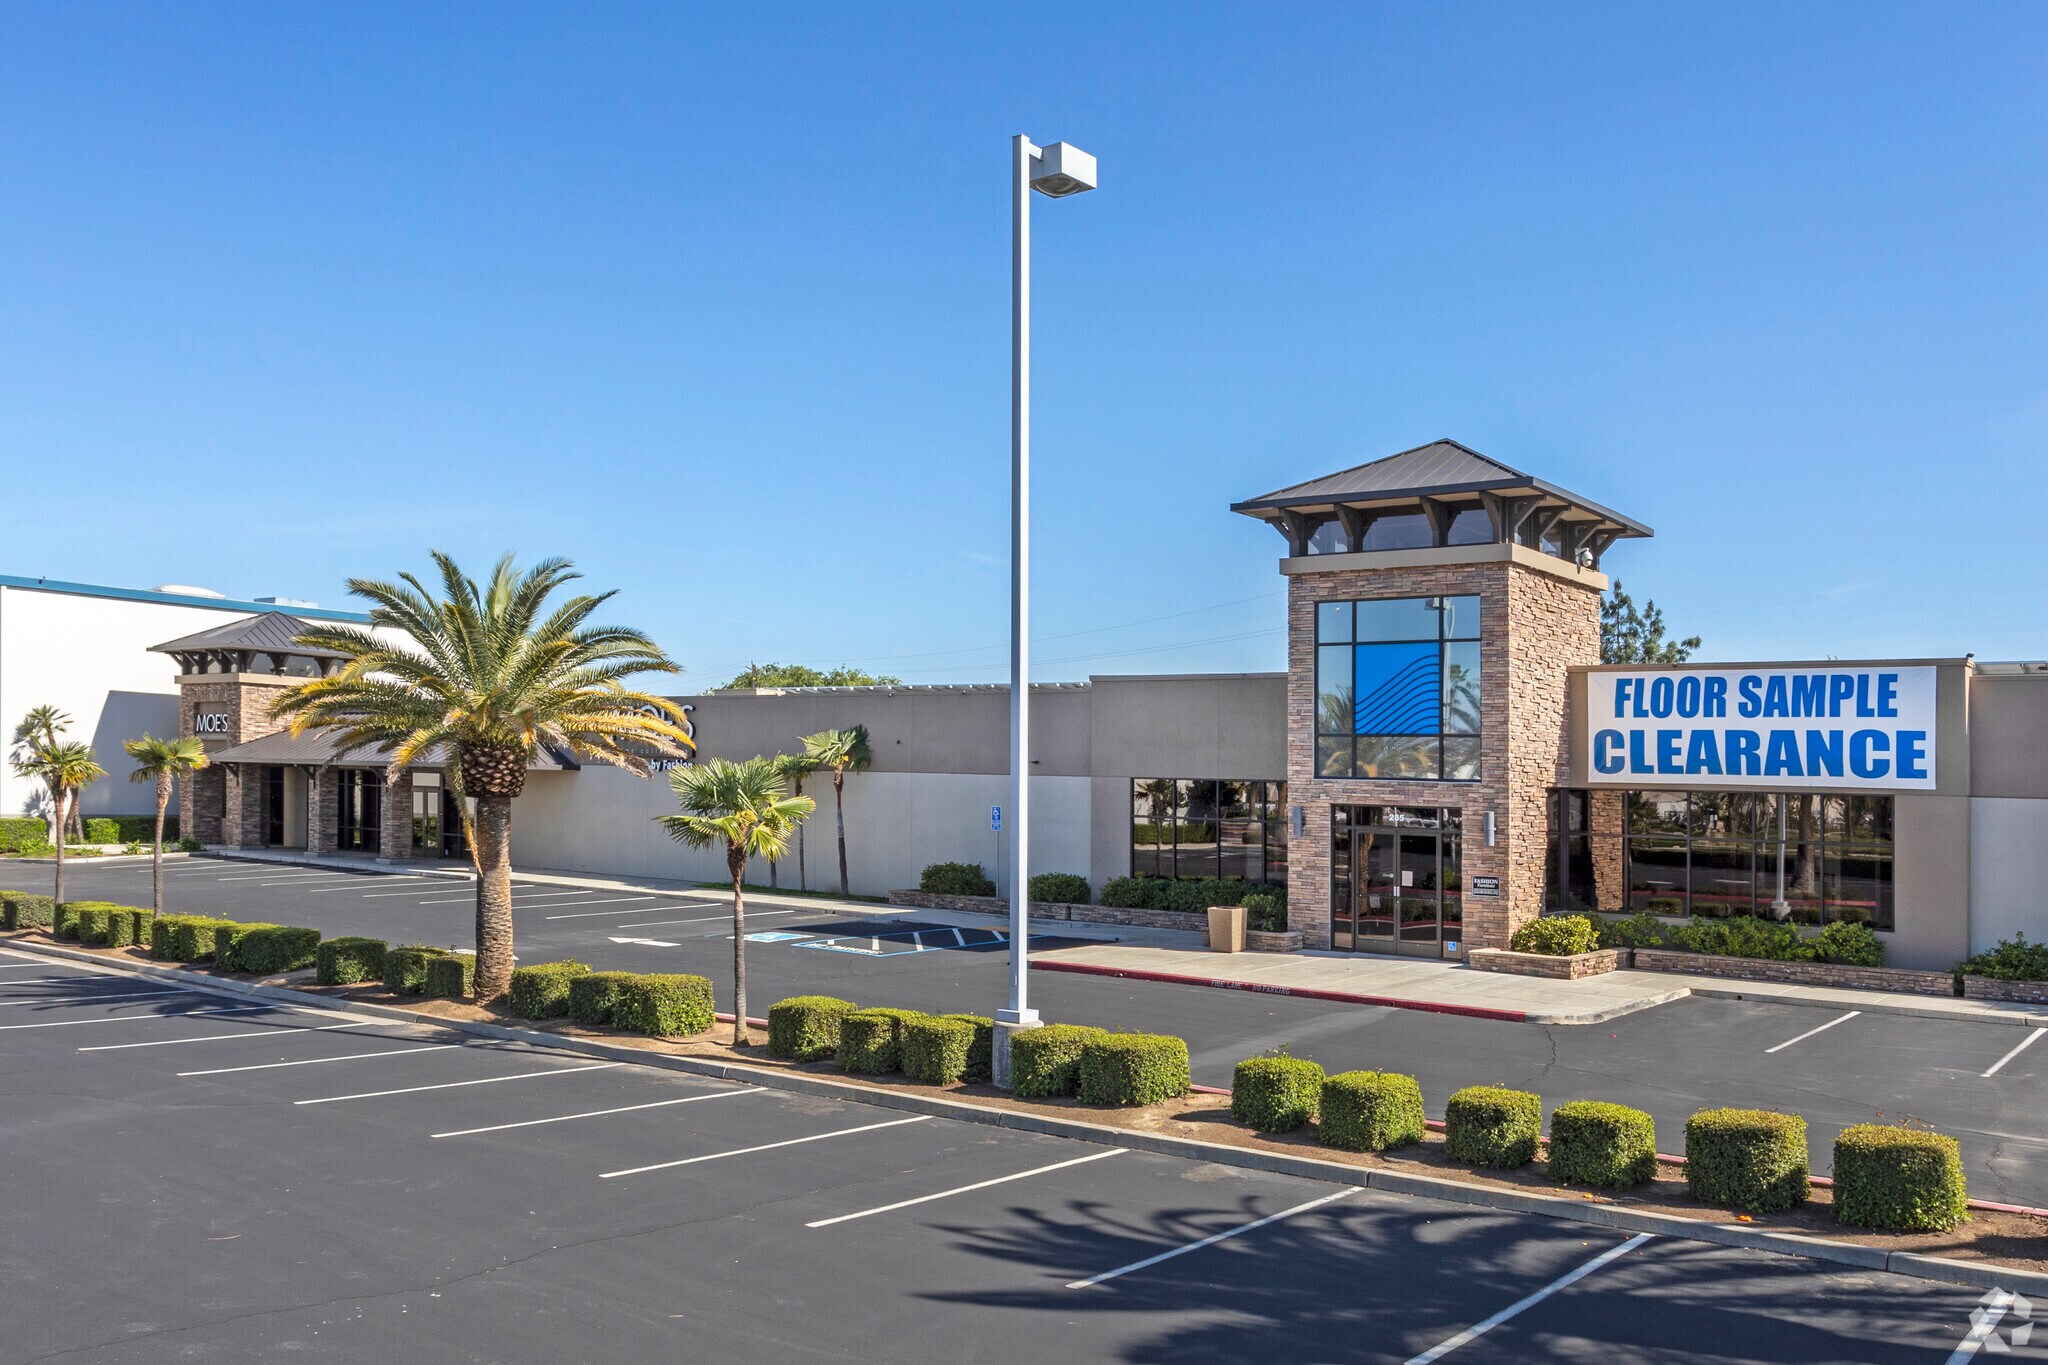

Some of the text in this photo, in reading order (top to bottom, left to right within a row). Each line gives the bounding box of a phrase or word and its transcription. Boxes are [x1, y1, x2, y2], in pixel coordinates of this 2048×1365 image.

[1614, 673, 1899, 718] FLOOR SAMPLE
[196, 713, 228, 732] MOE'S
[1593, 728, 1928, 779] CLEARANCE
[651, 758, 661, 772] by
[1389, 813, 1405, 822] 285
[1211, 980, 1290, 995] FIRE LANE NO PARKING
